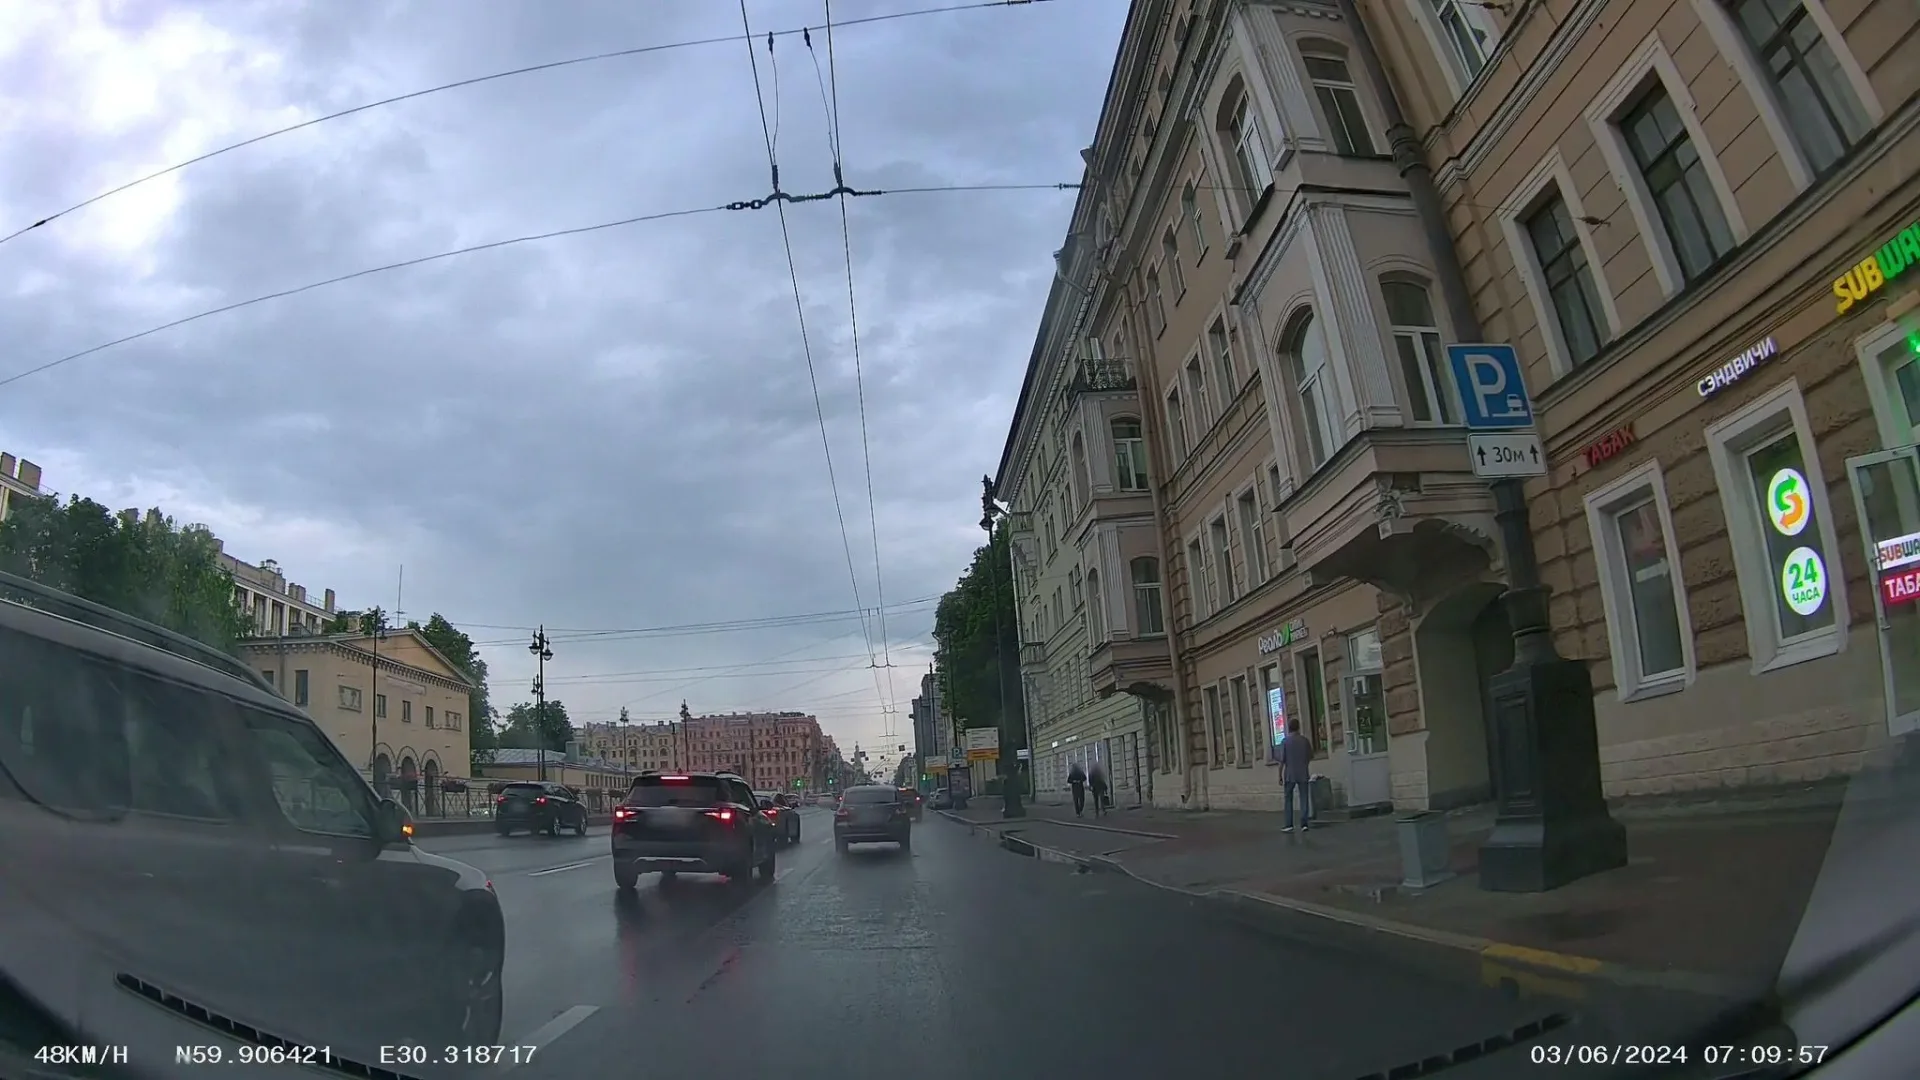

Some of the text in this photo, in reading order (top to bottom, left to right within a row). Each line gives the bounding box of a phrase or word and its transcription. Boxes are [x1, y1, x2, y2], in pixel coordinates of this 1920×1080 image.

[1464, 354, 1506, 417] P
[1697, 336, 1775, 398] СЭНДВИЧИ
[1580, 420, 1635, 467] ТАБАК
[1788, 557, 1818, 590] 24
[1792, 587, 1821, 604] ЧАСА
